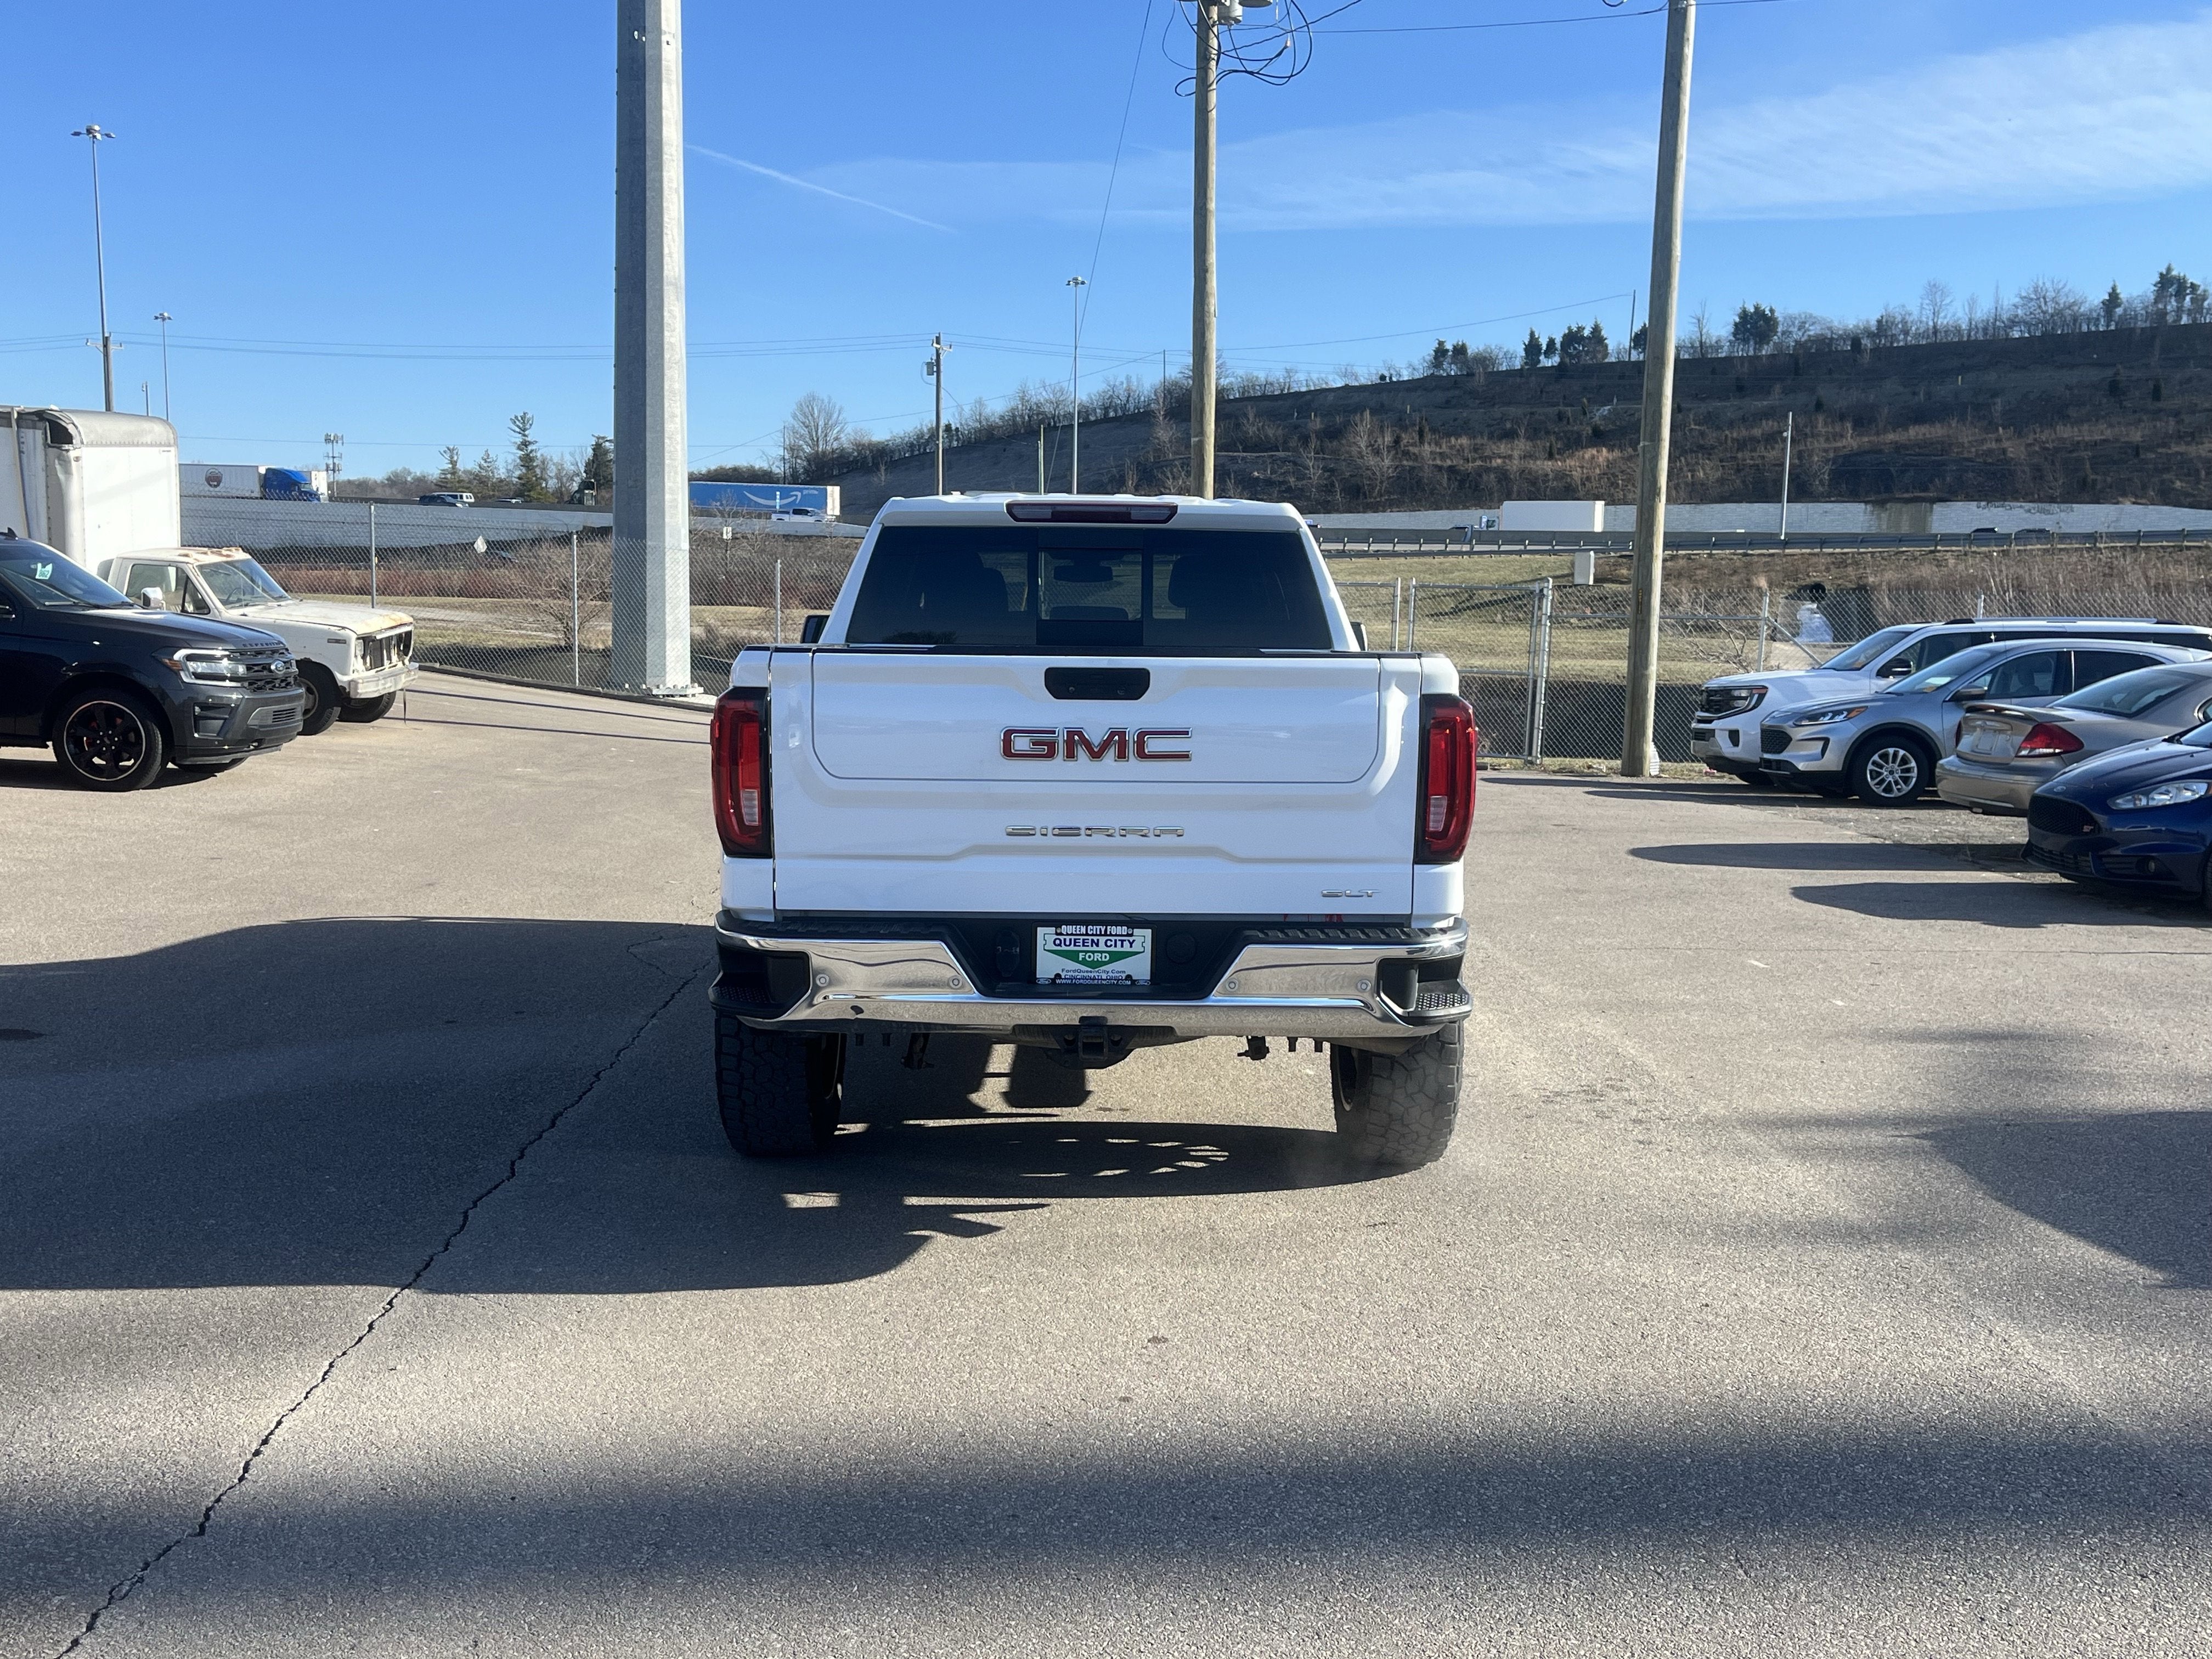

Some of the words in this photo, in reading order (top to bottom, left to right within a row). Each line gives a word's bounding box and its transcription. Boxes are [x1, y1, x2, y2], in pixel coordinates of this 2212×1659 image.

[1000, 726, 1193, 761] GMC
[1005, 825, 1185, 837] SIERRA
[1321, 889, 1381, 898] SLT
[1061, 925, 1086, 934] QUEEN
[1087, 926, 1105, 935] CITY
[1107, 926, 1127, 935] FORD
[1053, 938, 1100, 947] QUEEN
[1104, 939, 1136, 948] CITY
[1079, 952, 1110, 961] FORD
